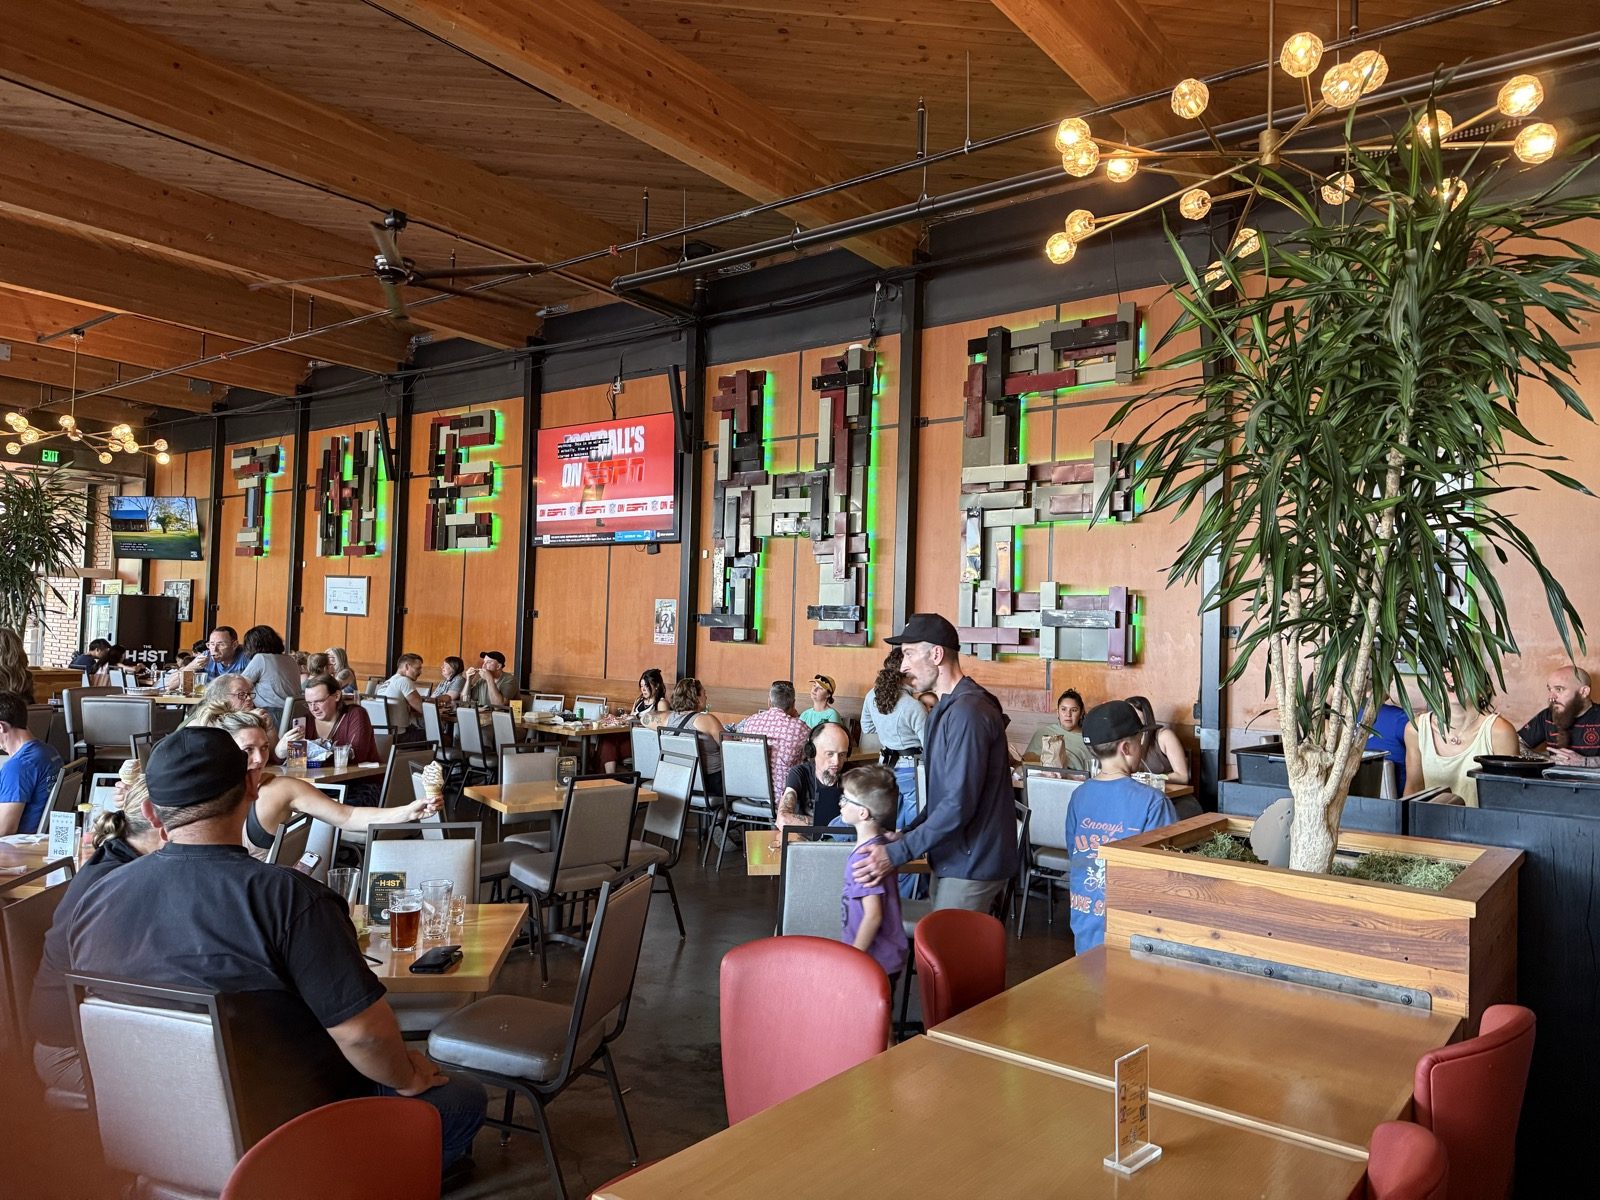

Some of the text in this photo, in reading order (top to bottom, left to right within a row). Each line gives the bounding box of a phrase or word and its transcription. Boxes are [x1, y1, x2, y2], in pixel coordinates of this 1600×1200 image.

[42, 449, 59, 462] EXIT
[562, 463, 583, 488] ON
[547, 507, 567, 517] ESPN
[585, 505, 606, 515] ESPN
[626, 502, 648, 512] ESPN
[1080, 817, 1124, 837] Snoopy's
